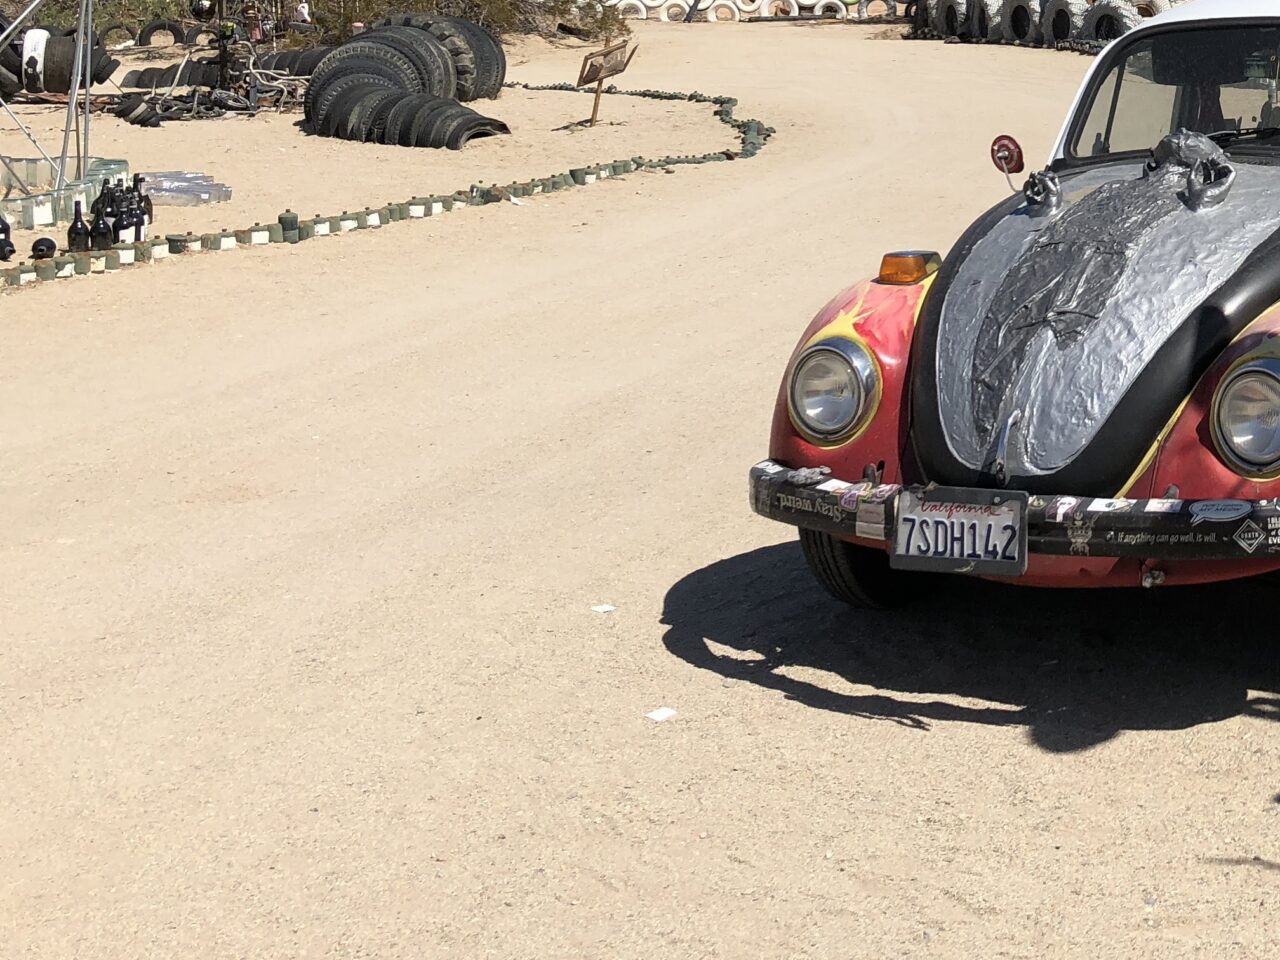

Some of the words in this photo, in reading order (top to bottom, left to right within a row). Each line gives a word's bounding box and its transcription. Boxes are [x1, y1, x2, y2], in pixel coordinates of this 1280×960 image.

[814, 497, 842, 522] Stay
[921, 499, 1001, 519] California
[902, 516, 1018, 561] 7SDH142
[1124, 532, 1154, 545] anything
[1156, 534, 1168, 543] can
